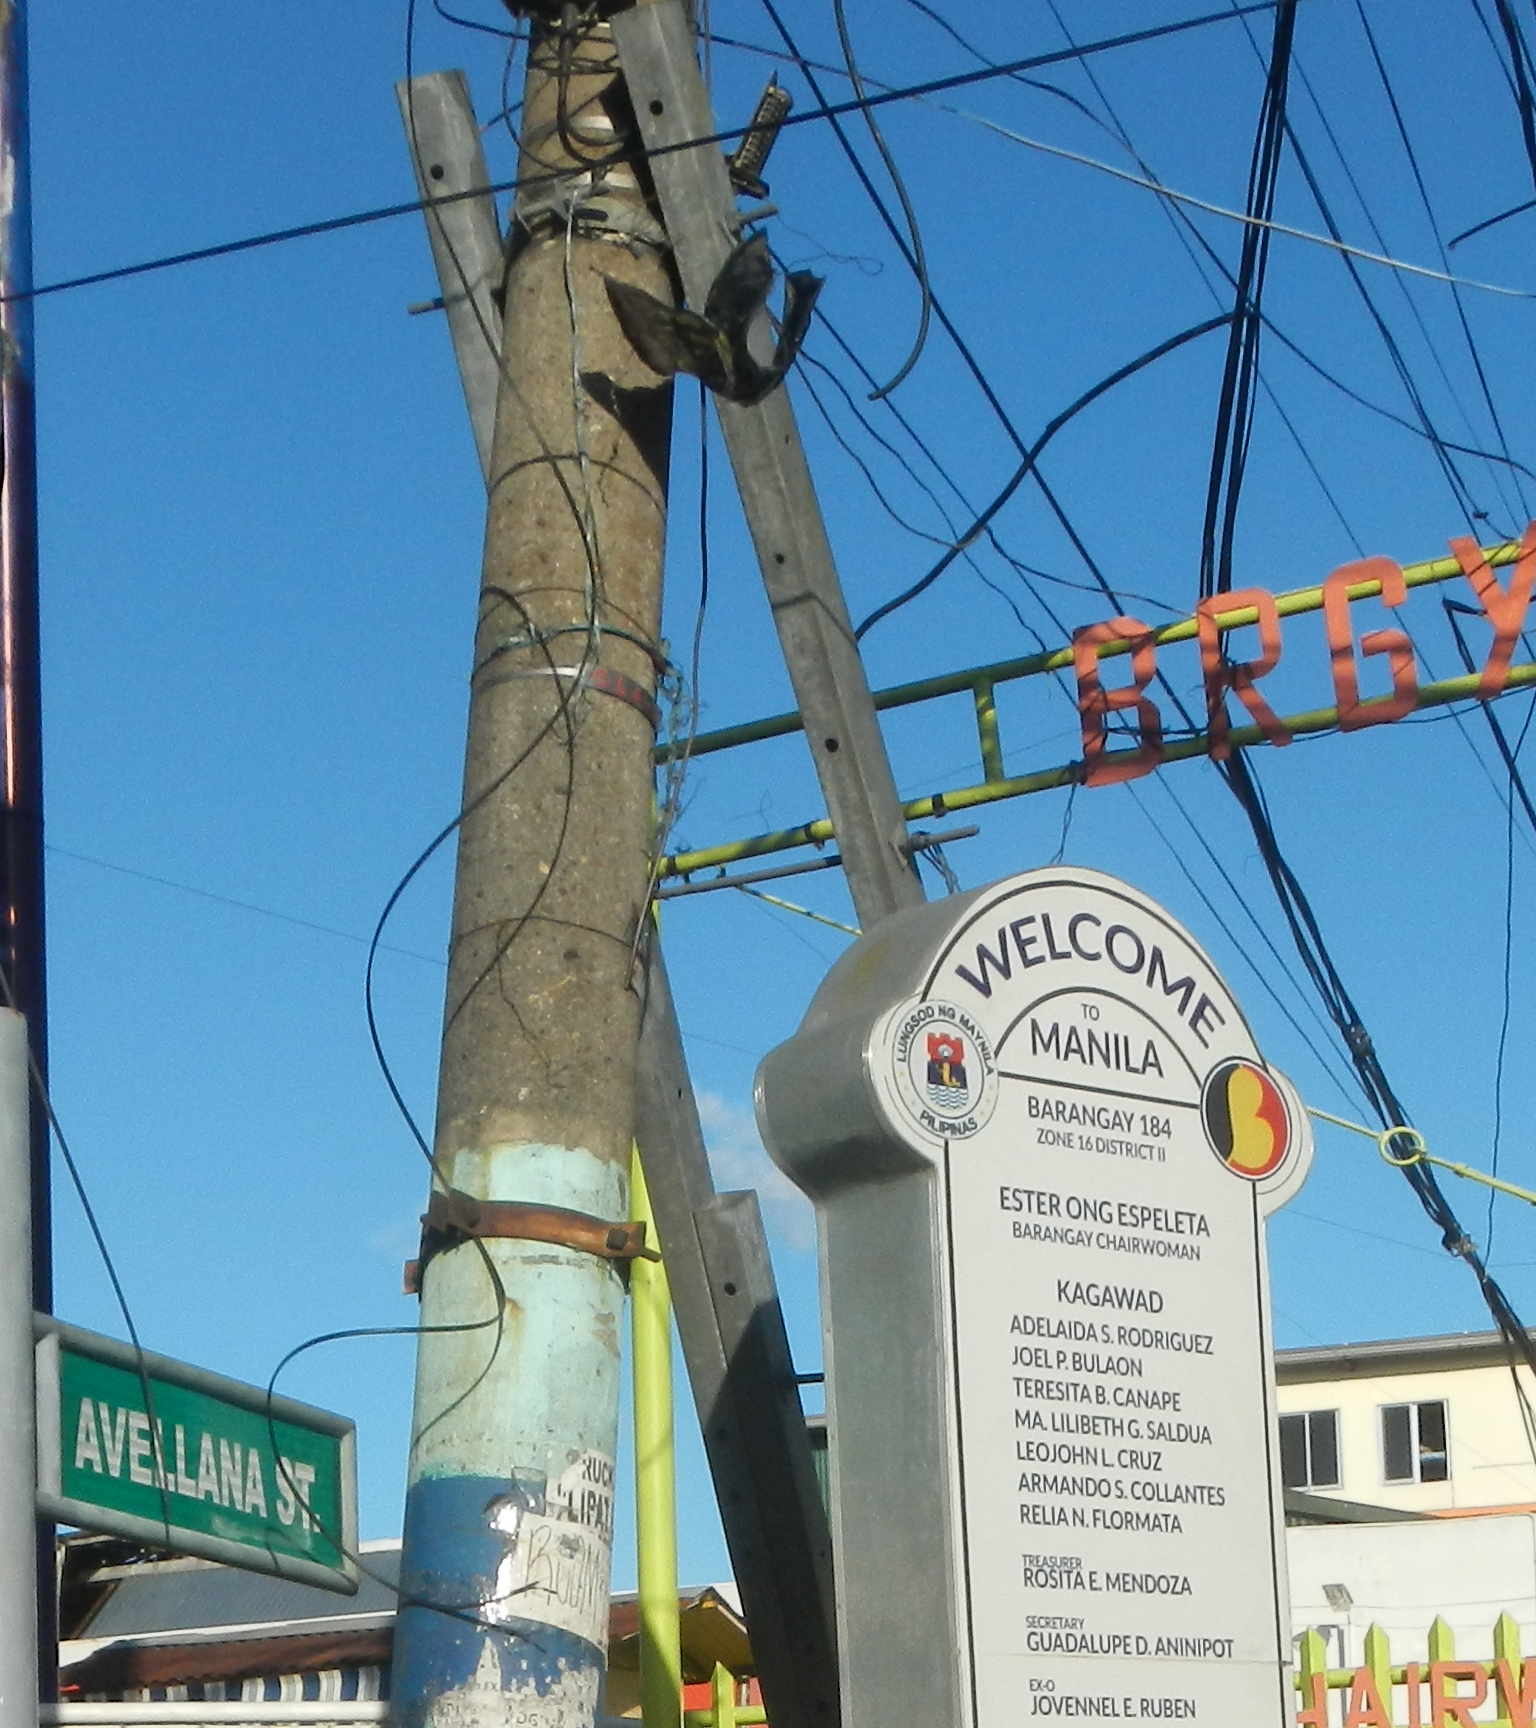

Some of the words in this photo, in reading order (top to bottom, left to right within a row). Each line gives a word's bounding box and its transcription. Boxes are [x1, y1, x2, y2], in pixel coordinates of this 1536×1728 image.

[955, 913, 1226, 1049] WELCOME
[1081, 1003, 1100, 1022] TO
[897, 1005, 935, 1063] LUNGSOD
[938, 1005, 956, 1020] NG
[959, 1014, 994, 1076] MAYNILA
[1030, 1018, 1164, 1078] MANILA
[920, 1110, 978, 1137] PILIPINAS
[1028, 1095, 1134, 1133] BARANGAY
[1140, 1112, 1172, 1140] 184
[1037, 1128, 1075, 1150] ZONE
[1078, 1134, 1094, 1152] 16
[1096, 1135, 1154, 1160] DISTRICT
[1158, 1146, 1167, 1163] II
[1000, 1187, 1062, 1219] ESTER
[1066, 1195, 1113, 1224] ONG
[1117, 1203, 1210, 1238] ESPELETA
[1012, 1221, 1094, 1249] BARANGAY
[1096, 1232, 1201, 1261] CHAIRWOMAN
[1057, 1280, 1164, 1314] KAGAWAD
[1010, 1315, 1099, 1342] ADELAIDA
[1101, 1325, 1114, 1344] S.
[1118, 1327, 1214, 1355] RODRIGUEZ
[1012, 1346, 1053, 1369] JOEL
[1056, 1351, 1069, 1371] P.
[1072, 1352, 1143, 1377] BULAON
[1013, 1377, 1092, 1404] TERESITA
[1096, 1384, 1110, 1405] B.
[1113, 1386, 1181, 1412] CANAPE
[1015, 1409, 1047, 1431] MA.
[1051, 1412, 1124, 1437] LILIBETH
[1128, 1419, 1143, 1439] G.
[1147, 1421, 1212, 1445] SALDUA
[74, 1397, 267, 1519] AVELLANA
[275, 1456, 322, 1534] ST.
[1017, 1441, 1098, 1466] LEOJOHN
[1101, 1448, 1114, 1468] L.
[1117, 1449, 1162, 1471] CRUZ
[1018, 1473, 1112, 1498] ARMANDO
[1115, 1480, 1128, 1500] S.
[1131, 1481, 1225, 1507] COLLANTES
[1020, 1504, 1069, 1527] RELIA
[1072, 1508, 1089, 1529] N.
[1092, 1509, 1183, 1534] FLORMATA
[1022, 1553, 1082, 1569] TREASURER
[1023, 1567, 1086, 1590] ROSITA
[1089, 1571, 1102, 1591] E.
[1106, 1572, 1193, 1596] MENDOZA
[1026, 1615, 1085, 1630] SECRETARY
[1026, 1632, 1132, 1656] GUADALUPE
[1135, 1636, 1152, 1657] D.
[1154, 1637, 1234, 1659] ANINIPOT
[1029, 1678, 1055, 1693] EX-O
[1031, 1695, 1121, 1718] JOVENNEL
[1123, 1697, 1137, 1718] E.
[1140, 1698, 1196, 1719] RUBEN
